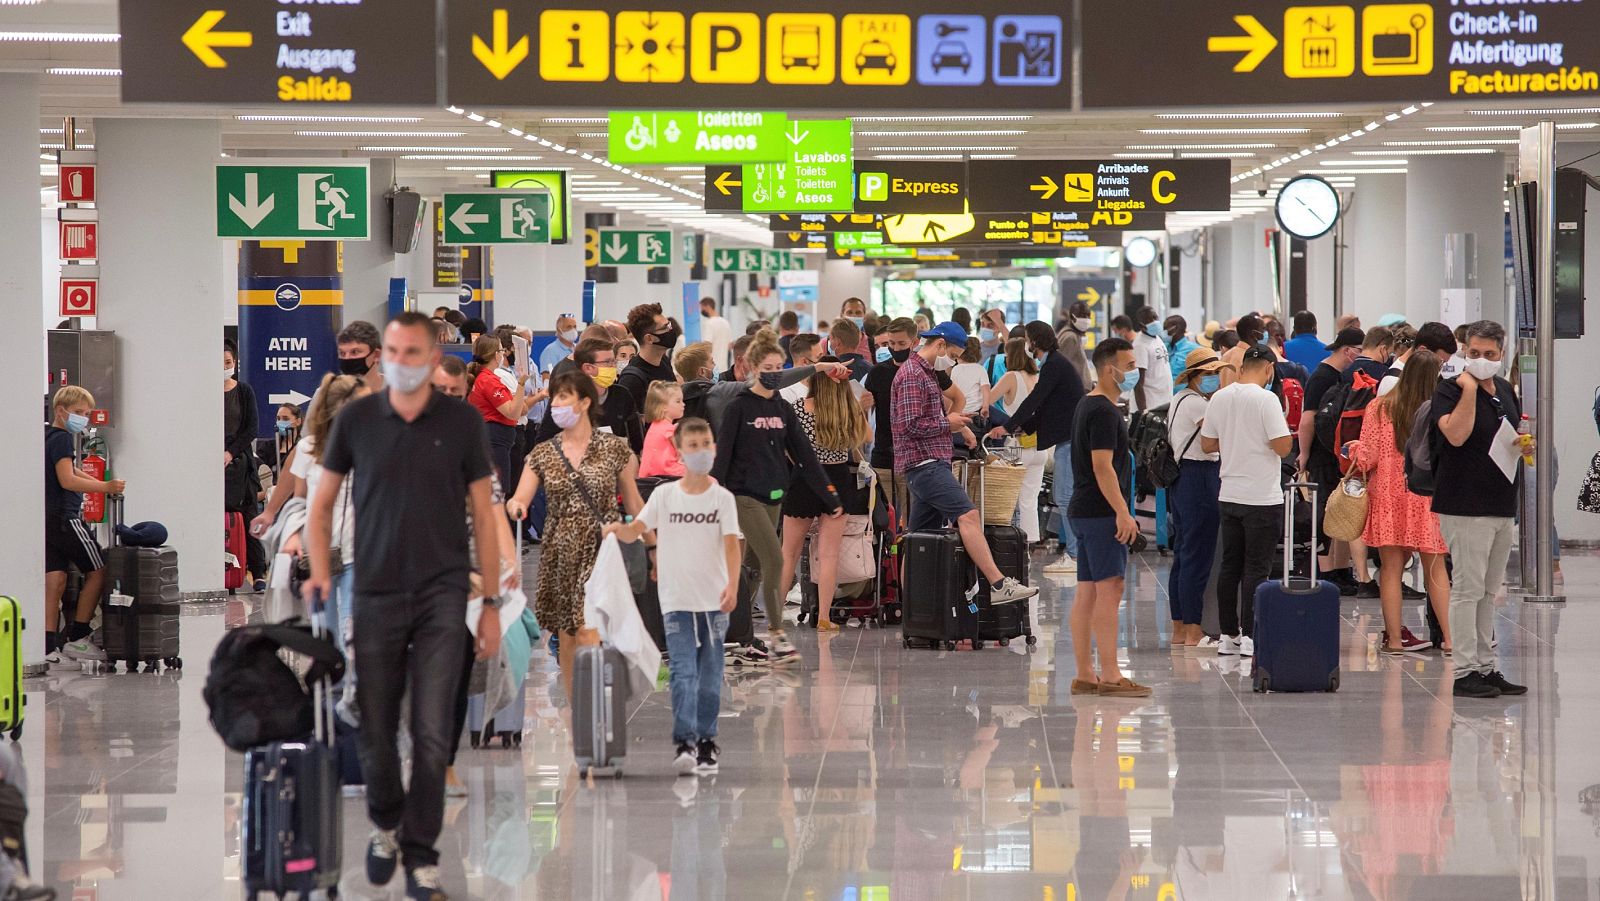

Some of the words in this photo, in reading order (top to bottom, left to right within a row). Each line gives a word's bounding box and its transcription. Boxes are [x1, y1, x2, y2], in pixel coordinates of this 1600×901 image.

[277, 11, 312, 36] Exit
[859, 20, 897, 33] TAXI
[1449, 10, 1538, 35] Check-in
[710, 25, 742, 71] P
[1449, 39, 1564, 66] Abfertigung
[277, 43, 356, 73] Ausgang
[1450, 66, 1599, 94] Facturación
[277, 76, 352, 101] Salida
[695, 131, 758, 150] Aseos
[794, 151, 847, 163] Lavabos
[795, 166, 827, 176] Toilets
[1097, 164, 1149, 173] Arribades
[795, 179, 837, 189] Toiletten
[866, 176, 882, 198] P
[892, 178, 959, 197] Express
[1097, 176, 1129, 185] Arrivals
[1151, 170, 1177, 204] C
[795, 192, 833, 204] Aseos
[1097, 187, 1130, 197] Ankunft
[1097, 200, 1146, 210] Llegadas
[989, 221, 1016, 229] Punto
[1017, 220, 1029, 229] de
[1052, 222, 1089, 231] Llegadas
[985, 231, 1030, 239] encuentro
[268, 337, 307, 351] ATM
[265, 357, 312, 371] HERE
[670, 509, 720, 523] mood.
